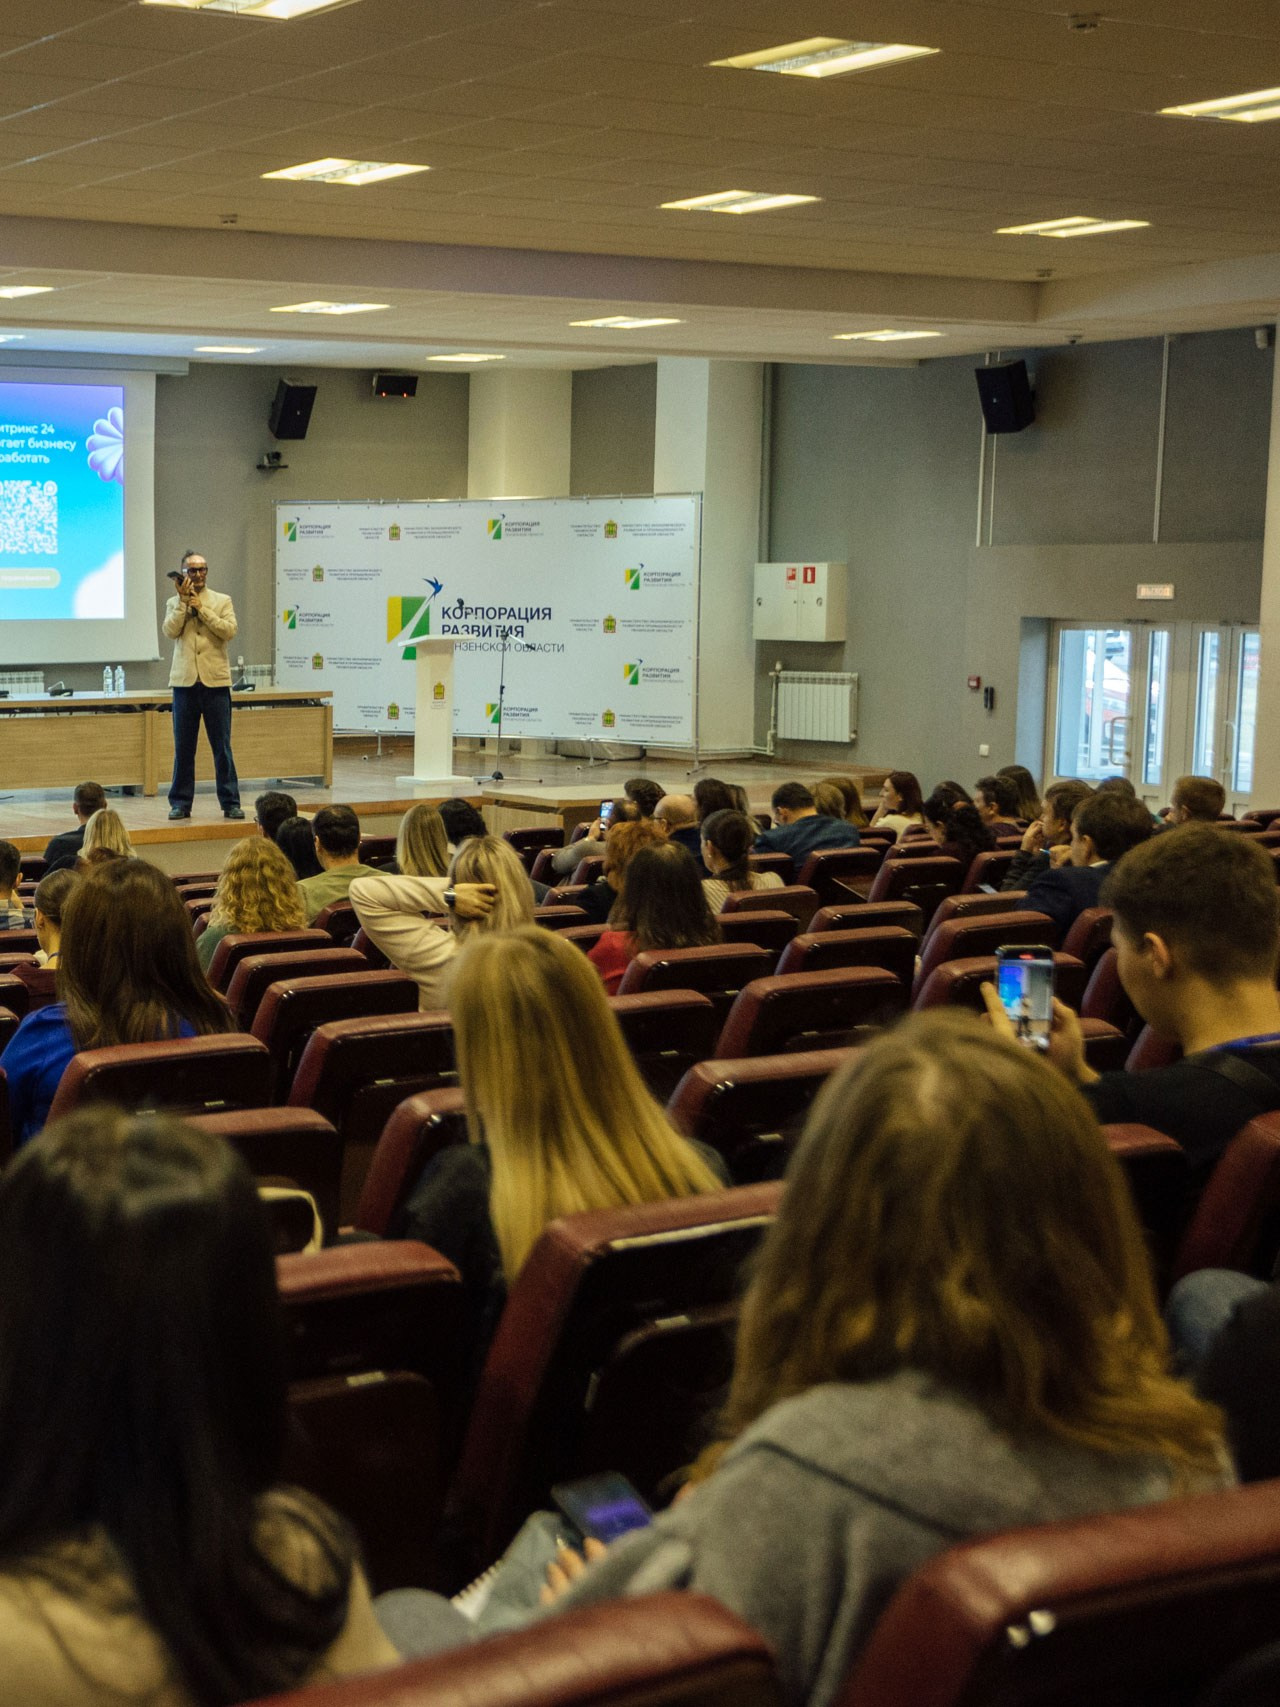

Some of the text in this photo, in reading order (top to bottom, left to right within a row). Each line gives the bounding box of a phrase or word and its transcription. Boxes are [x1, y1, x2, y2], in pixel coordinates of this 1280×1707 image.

[40, 423, 55, 435] 24
[27, 437, 77, 452] бизнесу
[441, 606, 552, 623] КОРПОРАЦИЯ
[441, 624, 525, 638] РАЗВИТИЯ
[453, 641, 512, 653] НЗЕНСКОЙ
